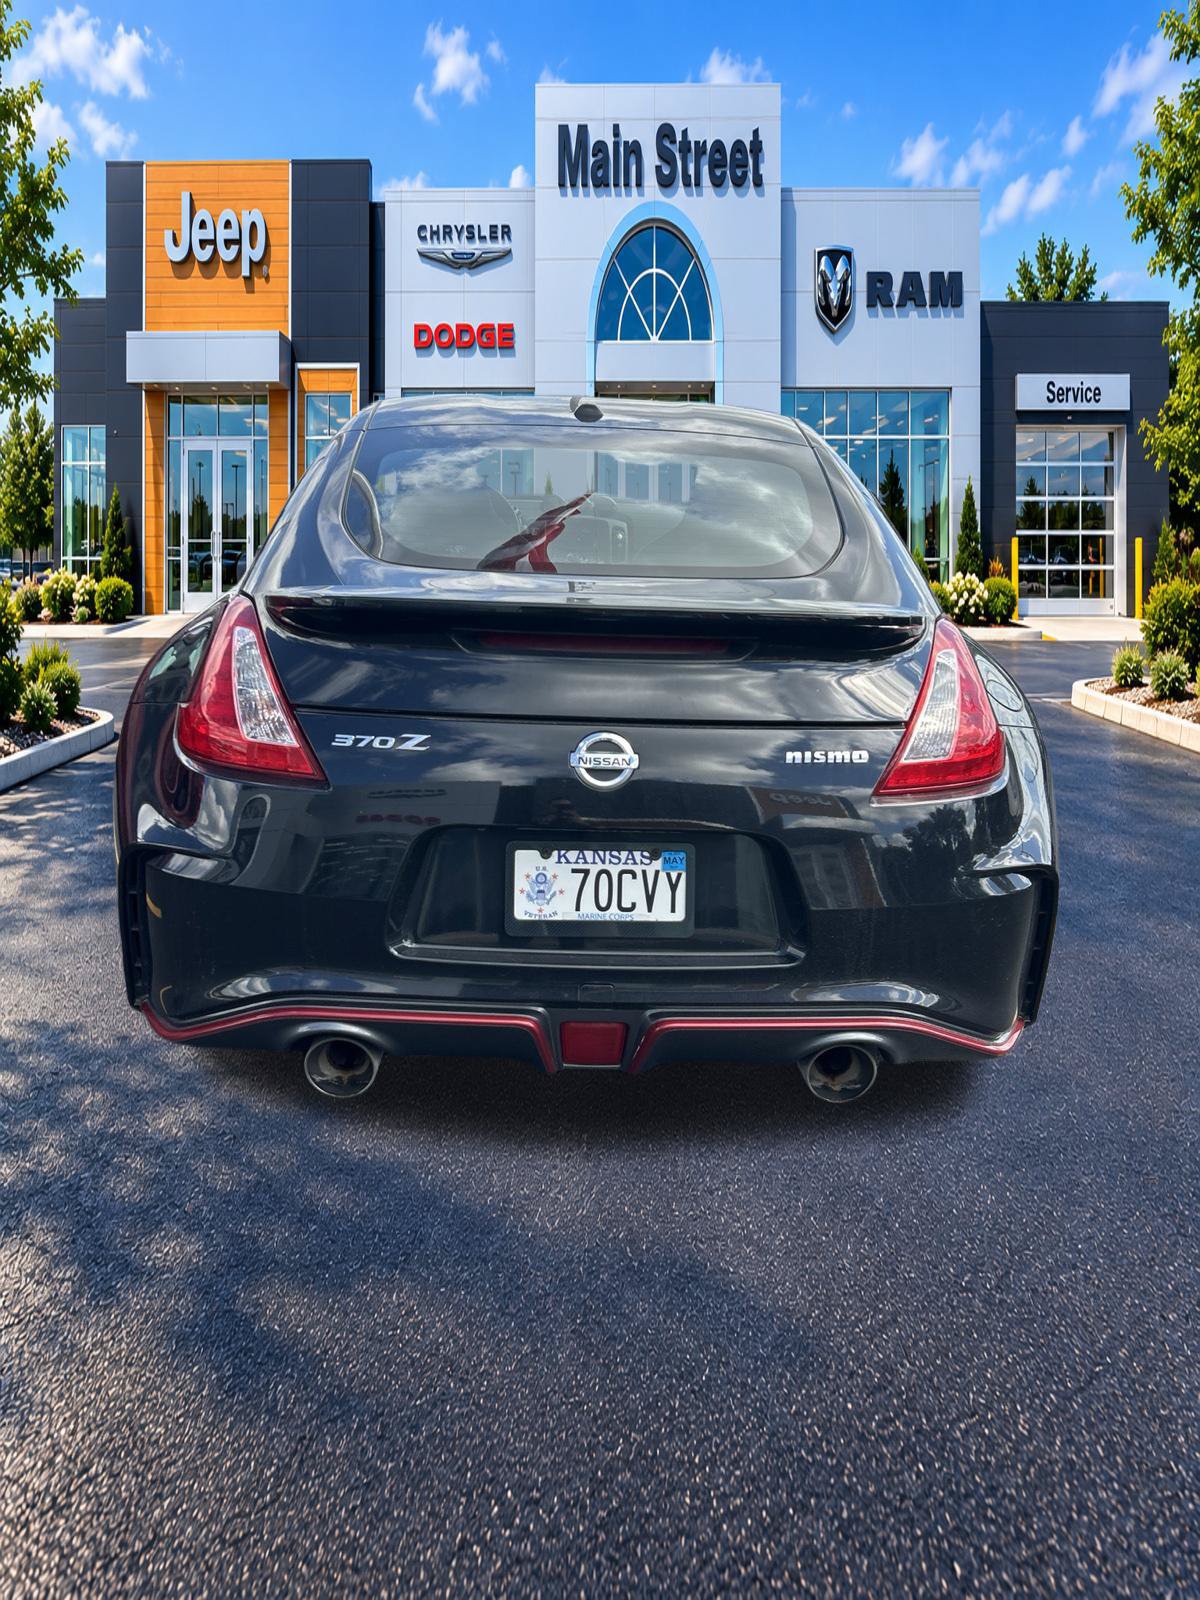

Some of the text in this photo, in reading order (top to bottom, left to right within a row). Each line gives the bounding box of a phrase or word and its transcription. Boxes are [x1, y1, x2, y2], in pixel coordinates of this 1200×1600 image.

[557, 122, 763, 188] Main Street
[164, 191, 267, 278] Jeep
[416, 224, 512, 242] CHRYSLER
[866, 271, 963, 308] RAM
[413, 322, 515, 349] DODGE
[1046, 380, 1102, 404] Service
[331, 733, 432, 751] 370Z
[578, 755, 631, 766] NISSAN
[555, 849, 654, 866] KANSAS
[663, 856, 685, 865] MAY
[570, 868, 683, 914] 70CVY
[524, 910, 558, 919] VETERAN
[577, 912, 635, 920] MARINE CORPS
